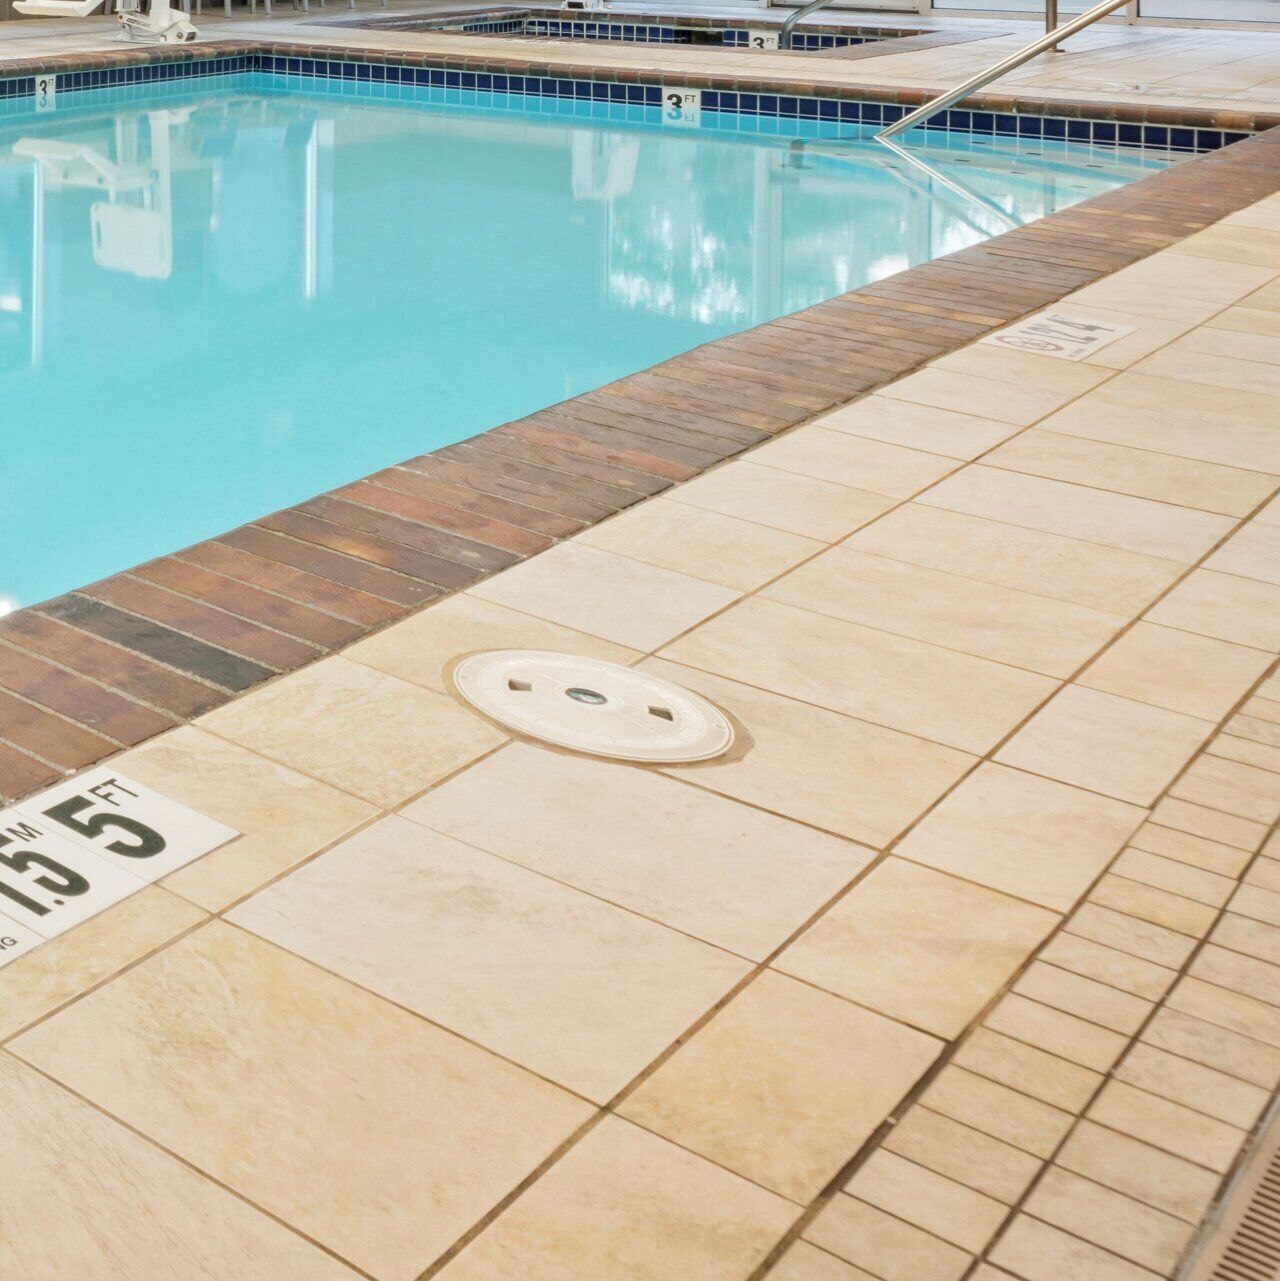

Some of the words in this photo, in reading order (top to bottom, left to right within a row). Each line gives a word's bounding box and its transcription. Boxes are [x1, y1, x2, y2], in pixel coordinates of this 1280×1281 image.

[753, 37, 765, 49] 3
[666, 94, 683, 109] 3
[684, 94, 696, 103] FT
[89, 778, 140, 807] FT
[6, 821, 44, 842] M
[42, 795, 167, 860] 5
